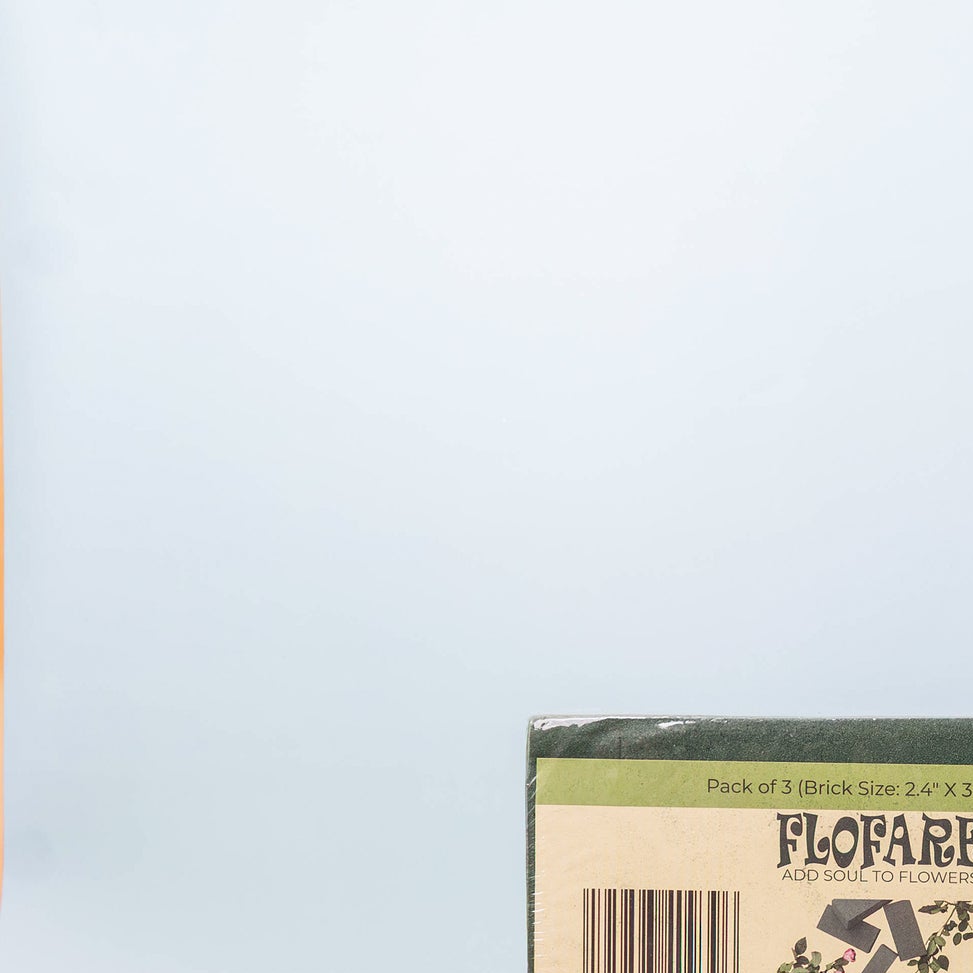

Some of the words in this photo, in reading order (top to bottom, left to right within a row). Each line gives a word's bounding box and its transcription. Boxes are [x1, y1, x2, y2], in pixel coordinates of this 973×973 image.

[707, 779, 753, 794] Pack
[758, 779, 777, 795] of
[781, 780, 792, 795] 3
[798, 779, 853, 799] (Brick
[858, 781, 901, 797] Size:
[905, 782, 939, 797] 2.4"
[945, 782, 957, 797] X
[782, 868, 819, 882] ADD
[823, 869, 868, 882] SOUL
[871, 870, 894, 883] TO
